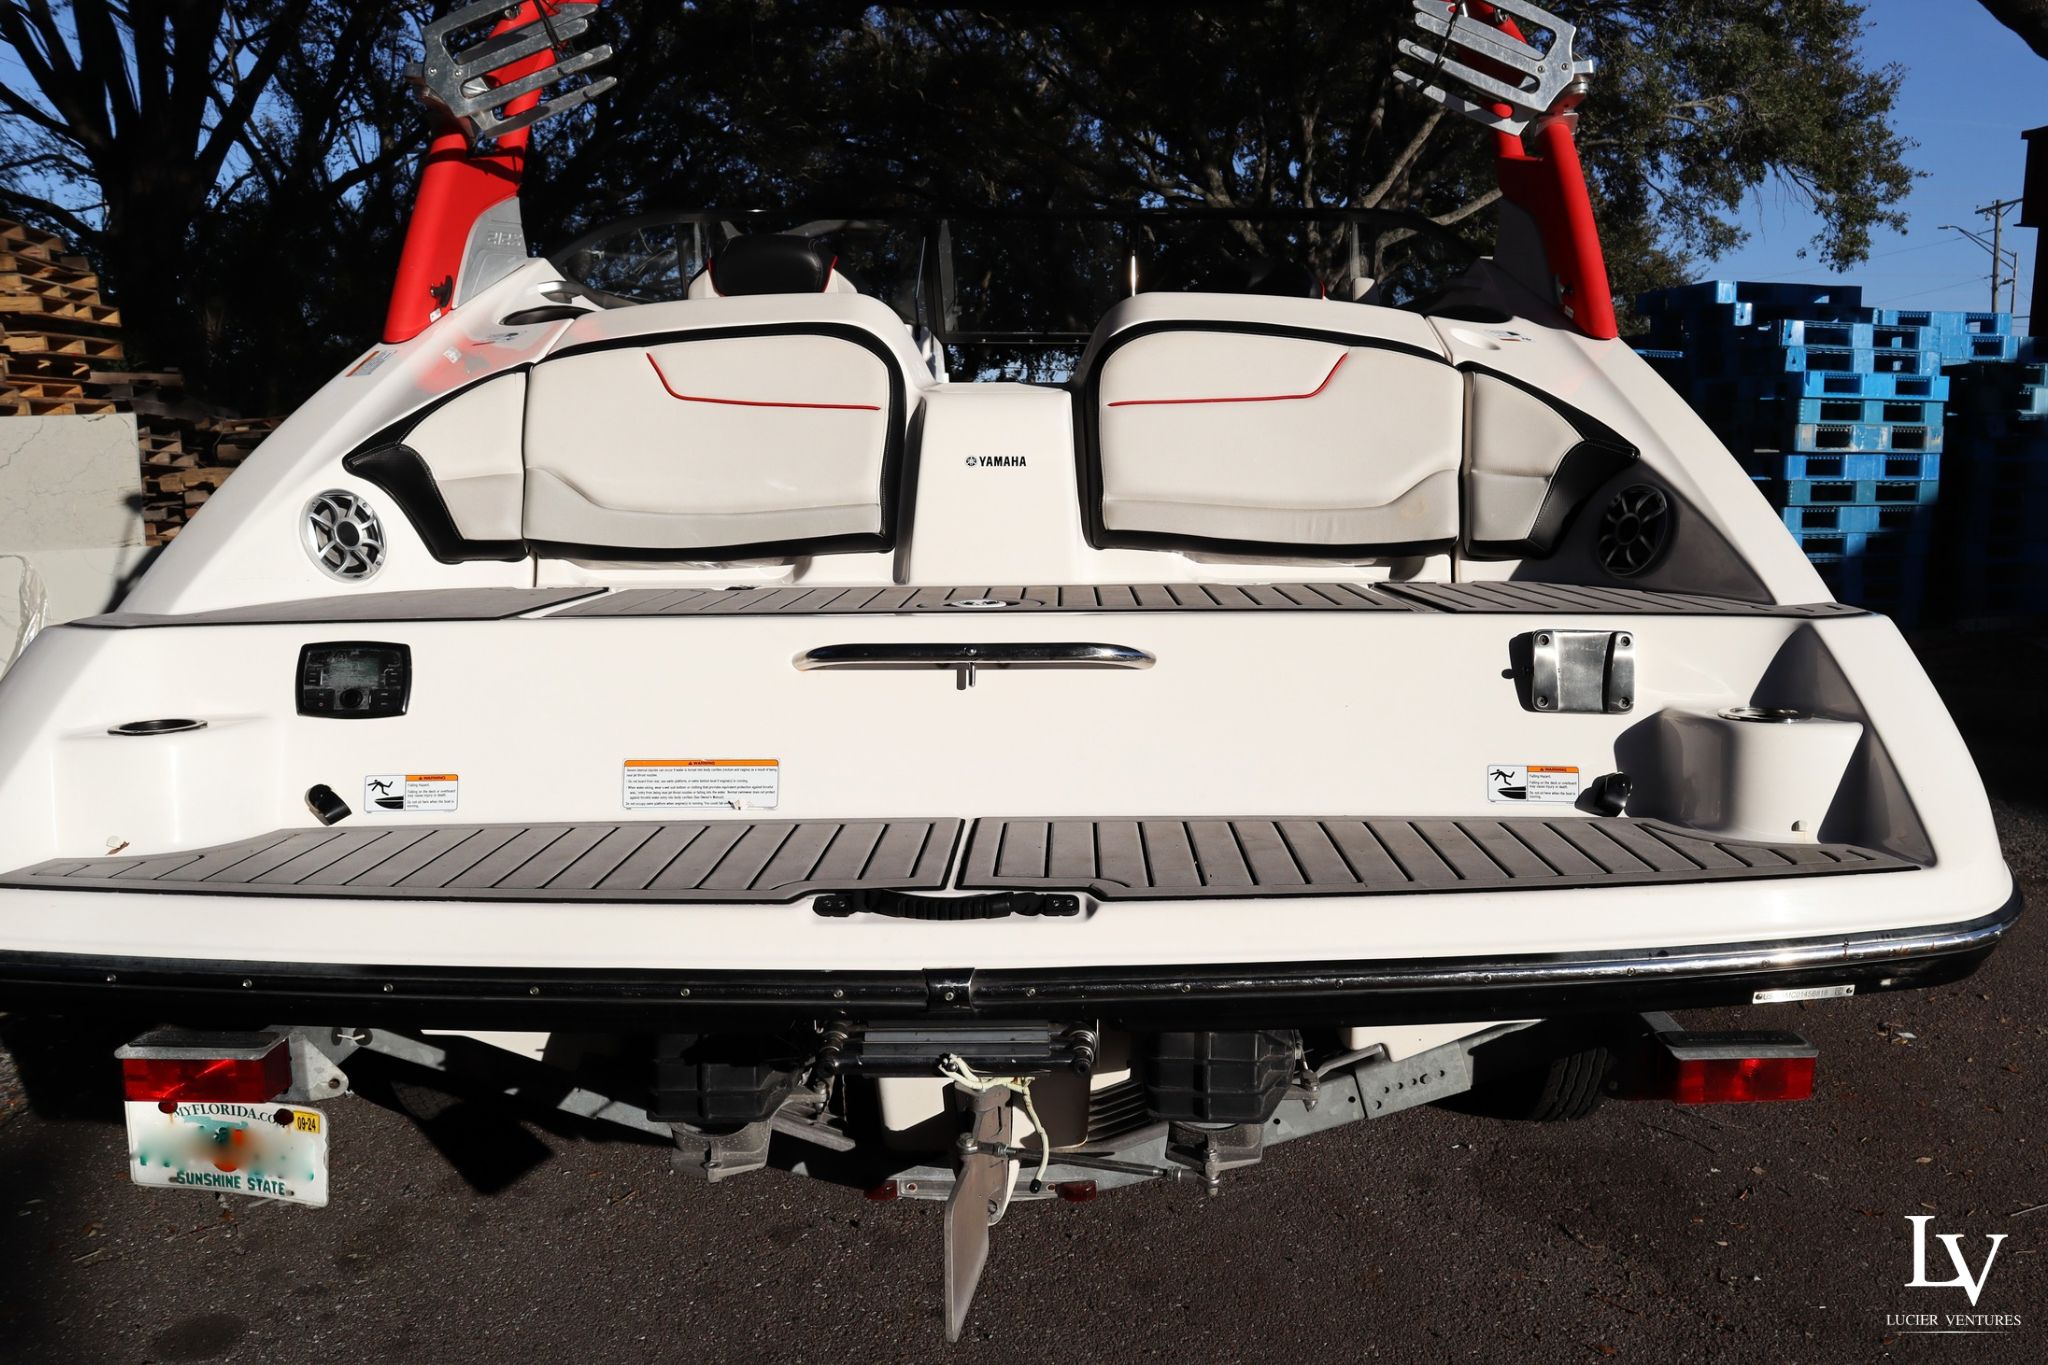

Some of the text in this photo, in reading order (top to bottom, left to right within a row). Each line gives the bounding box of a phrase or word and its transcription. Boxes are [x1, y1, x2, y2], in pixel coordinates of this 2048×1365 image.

[979, 456, 1027, 467] YAMAHA
[173, 1103, 287, 1128] MYFLORIDA.CO
[297, 1116, 316, 1132] 09-24
[176, 1171, 286, 1196] SUNSHINE STATE
